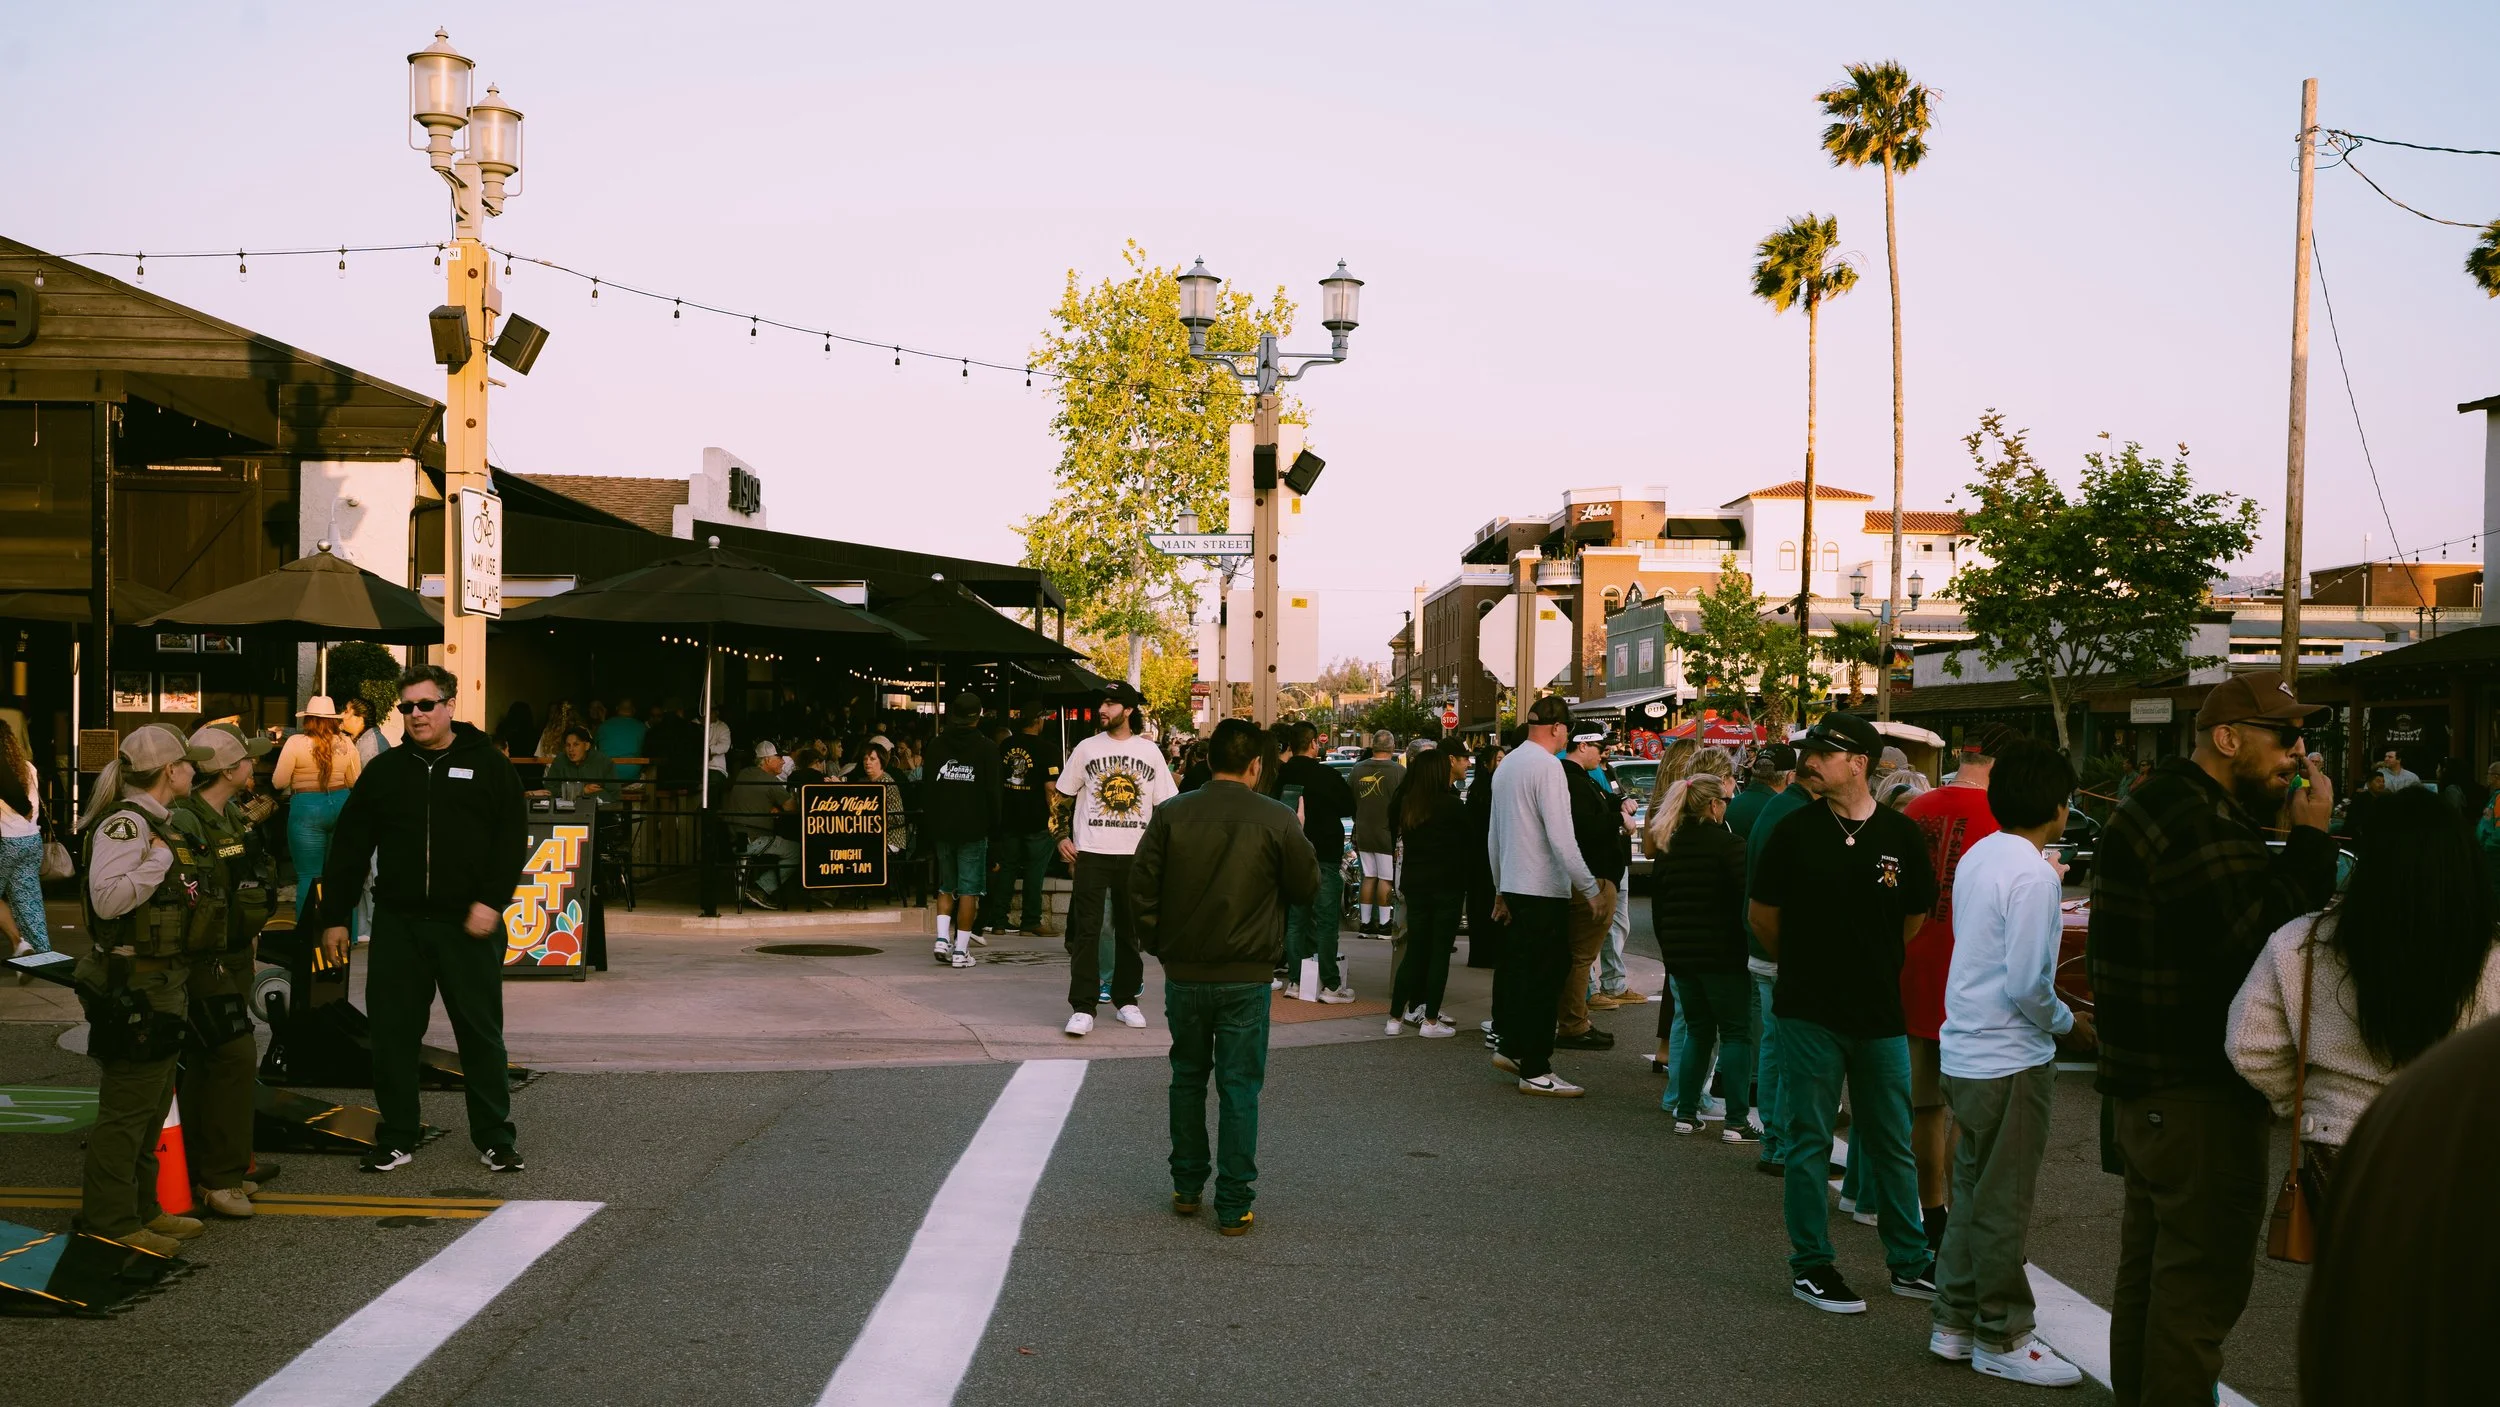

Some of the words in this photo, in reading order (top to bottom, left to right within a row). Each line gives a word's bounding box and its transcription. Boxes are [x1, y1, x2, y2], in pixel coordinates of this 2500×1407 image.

[1581, 503, 1612, 520] Luke's
[1161, 540, 1196, 549] MAIN
[1203, 540, 1252, 549] STREET
[471, 552, 483, 572] MAY
[486, 556, 496, 576] USE
[466, 579, 482, 599] FULL
[484, 583, 498, 603] LANE
[1647, 705, 1665, 714] PUB
[1442, 716, 1458, 724] STOP
[2387, 728, 2422, 741] JERKY
[1085, 756, 1129, 781] ROLLING
[1131, 757, 1155, 782] LOUD
[809, 795, 840, 813] Late
[840, 795, 879, 816] Night
[807, 815, 882, 835] BRUNCHIES
[1105, 819, 1138, 828] ANGELES
[830, 849, 862, 861] TONIGHT
[819, 863, 830, 875] 10
[830, 863, 844, 874] PM
[858, 862, 872, 873] AM
